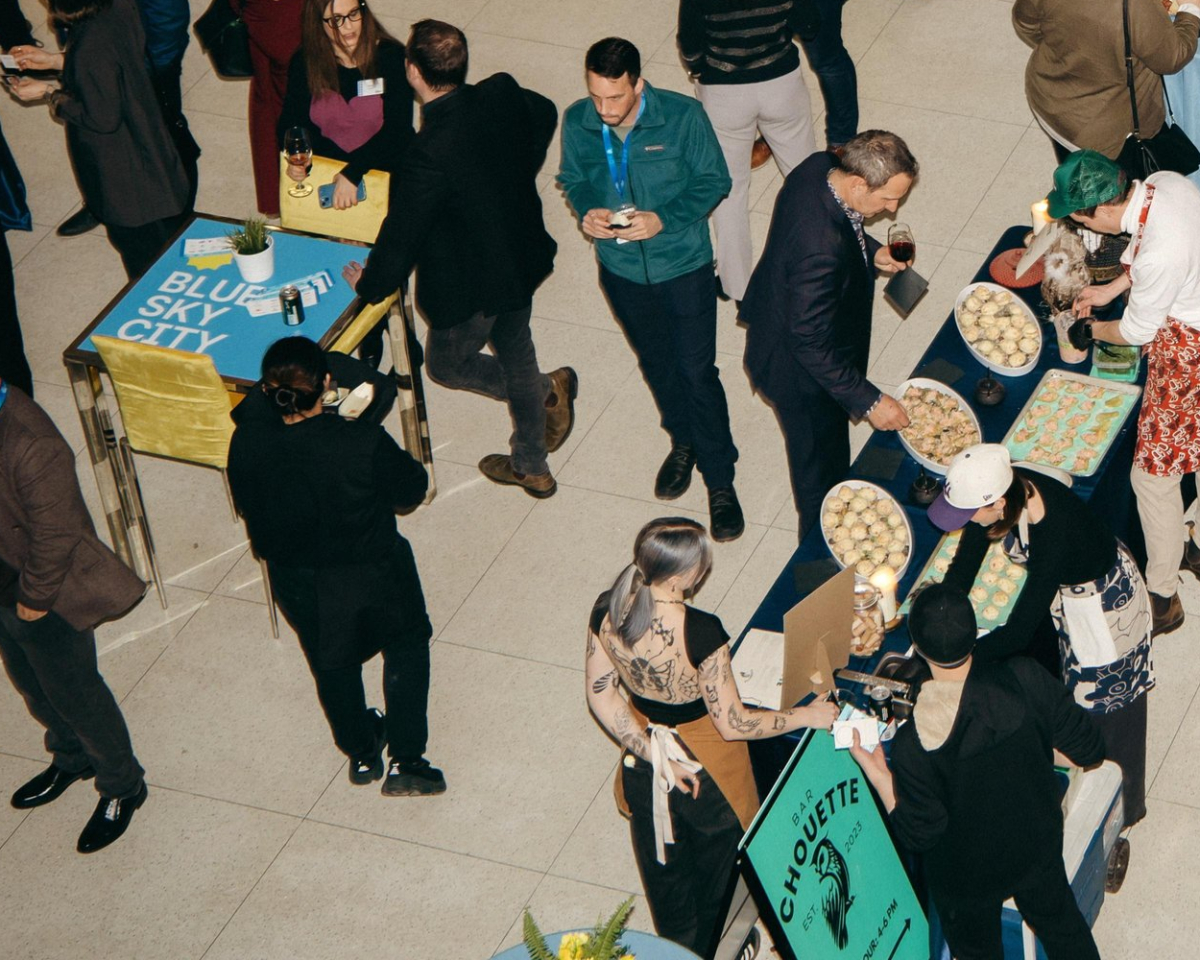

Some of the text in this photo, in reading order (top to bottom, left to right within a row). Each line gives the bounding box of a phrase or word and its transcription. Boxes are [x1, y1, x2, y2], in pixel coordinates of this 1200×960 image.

[158, 271, 264, 307] BLUE
[138, 295, 231, 327] SKY
[117, 318, 228, 354] CITY
[791, 789, 813, 827] BAR
[780, 777, 859, 924] CHOUETTE
[844, 820, 863, 853] 2023
[802, 903, 819, 932] EST.
[877, 916, 889, 937] 4-6
[887, 898, 898, 919] PM
